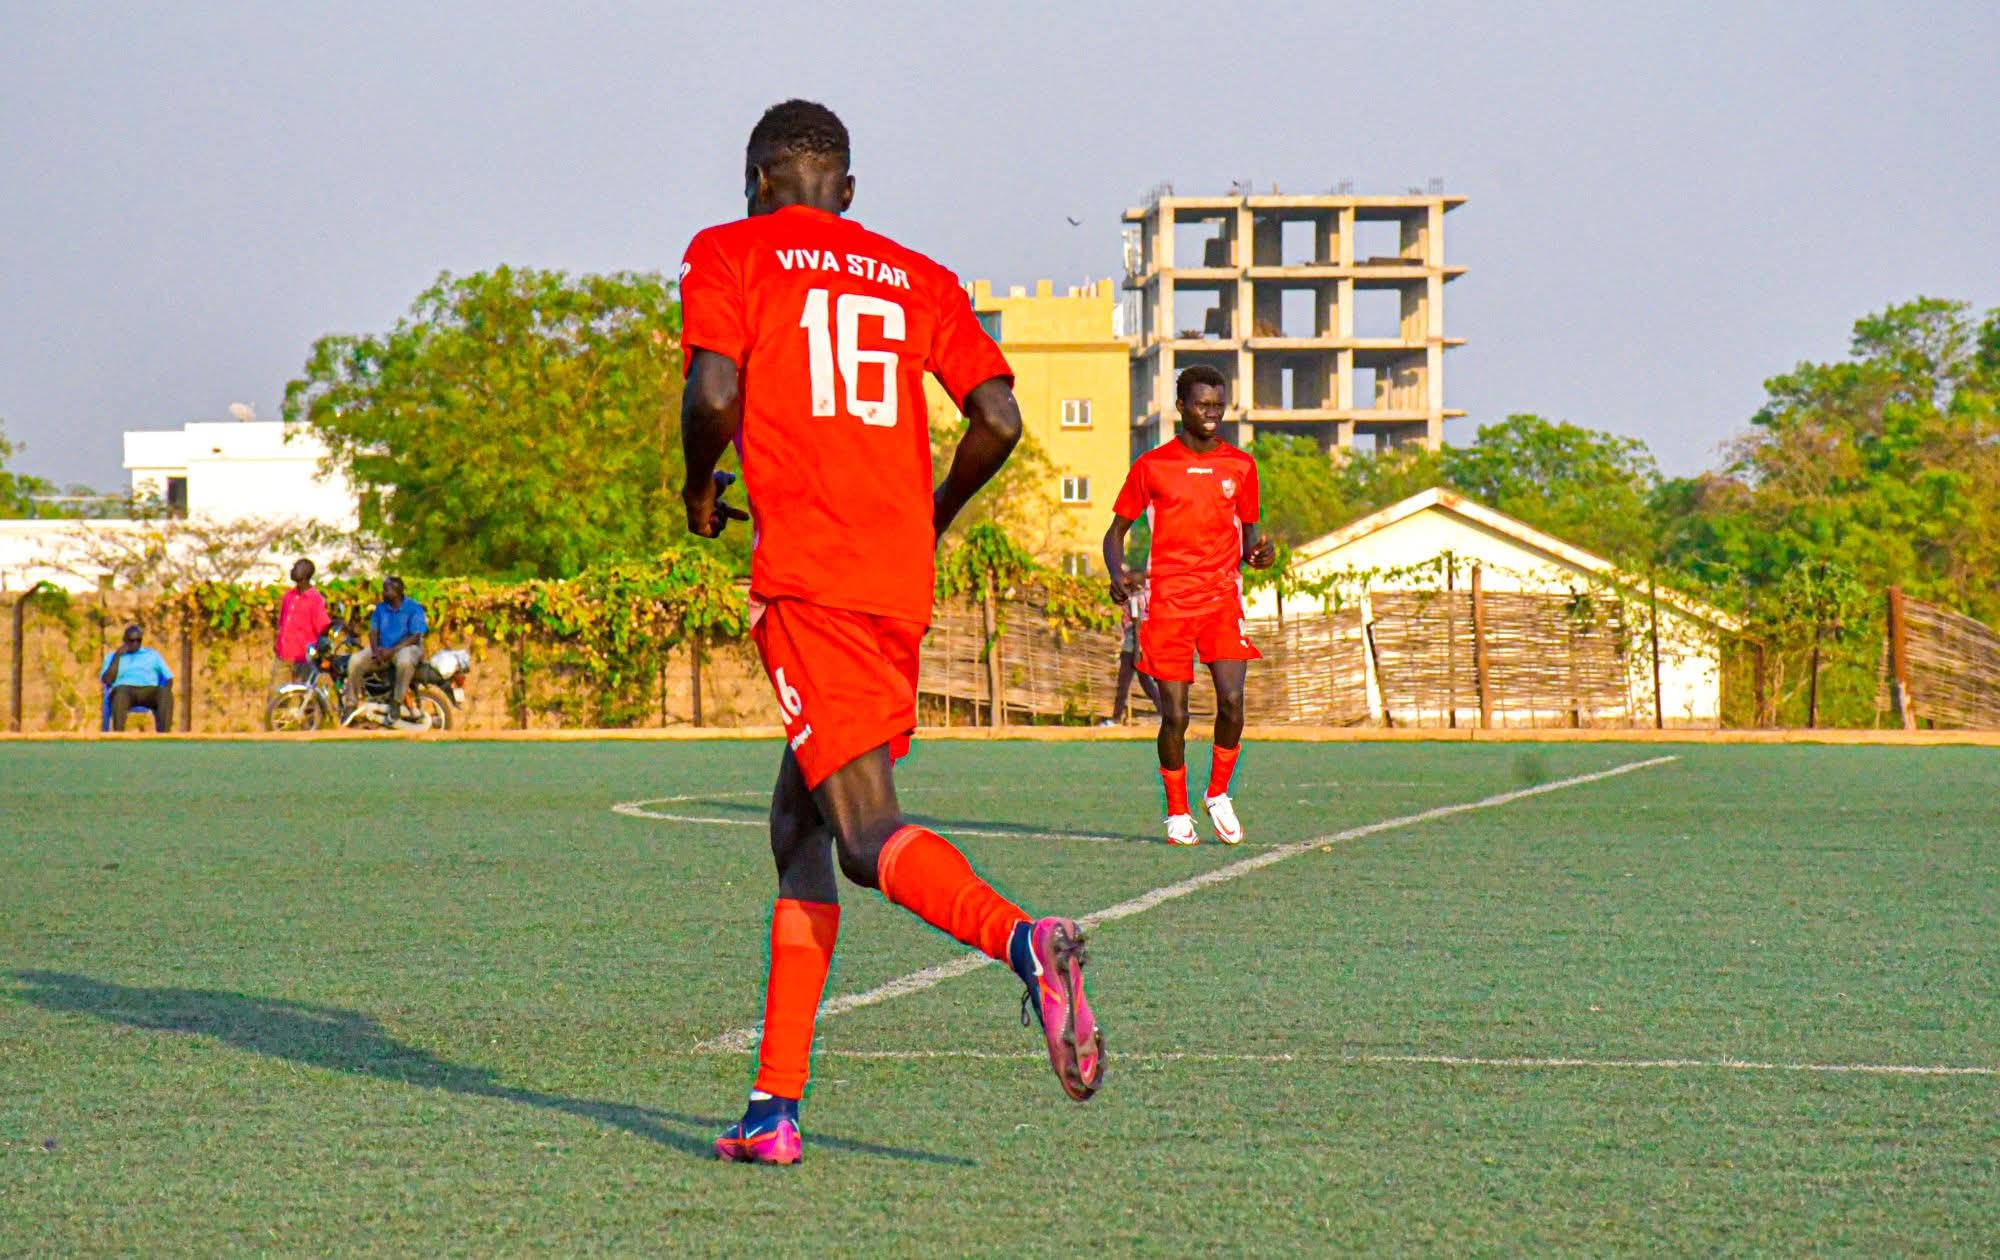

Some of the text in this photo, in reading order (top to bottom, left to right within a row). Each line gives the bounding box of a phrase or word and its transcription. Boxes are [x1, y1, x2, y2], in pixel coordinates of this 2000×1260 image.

[776, 249, 911, 290] VIVA STAR
[799, 288, 906, 427] 16
